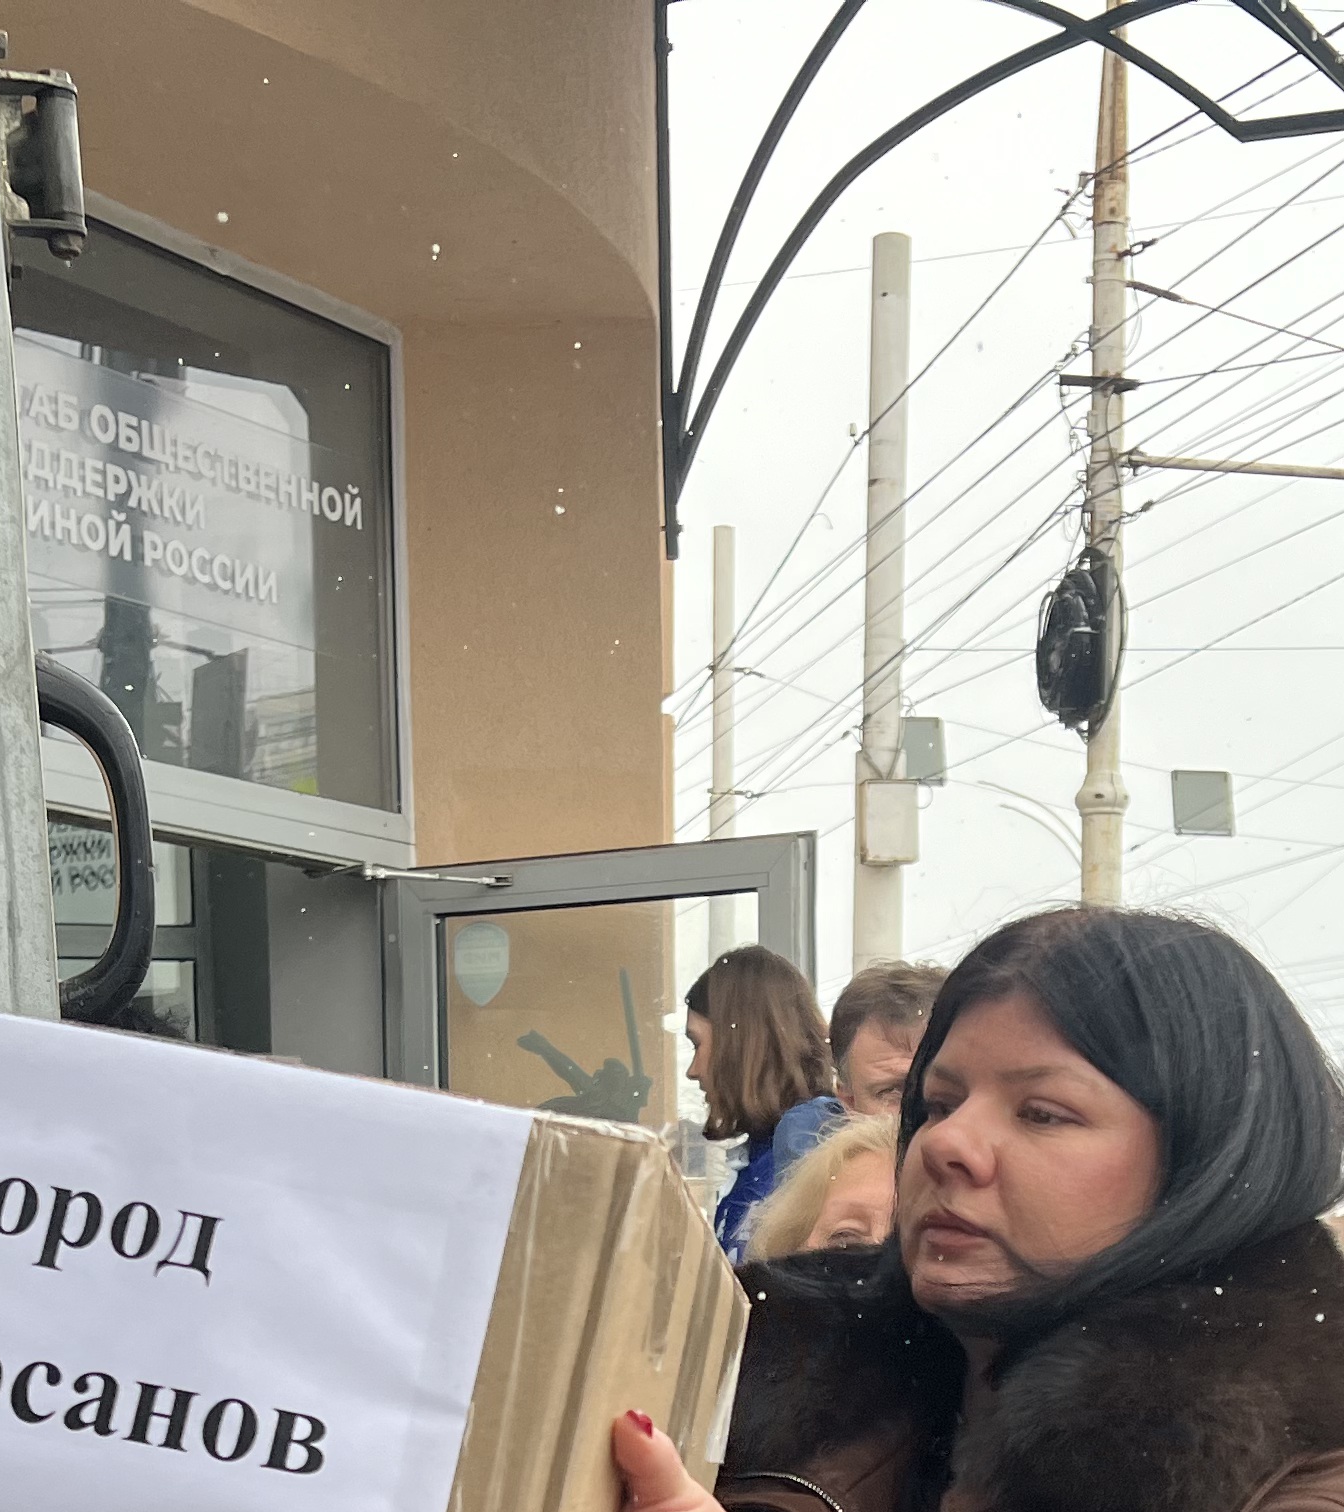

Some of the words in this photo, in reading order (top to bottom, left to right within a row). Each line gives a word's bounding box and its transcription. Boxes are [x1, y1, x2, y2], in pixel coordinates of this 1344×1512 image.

[25, 439, 205, 529] ДДЕРЖКИ
[90, 403, 363, 530] ОБЩЕСТВЕННОЙ
[26, 494, 132, 562] ИНОЙ
[142, 530, 277, 604] РОССИИ
